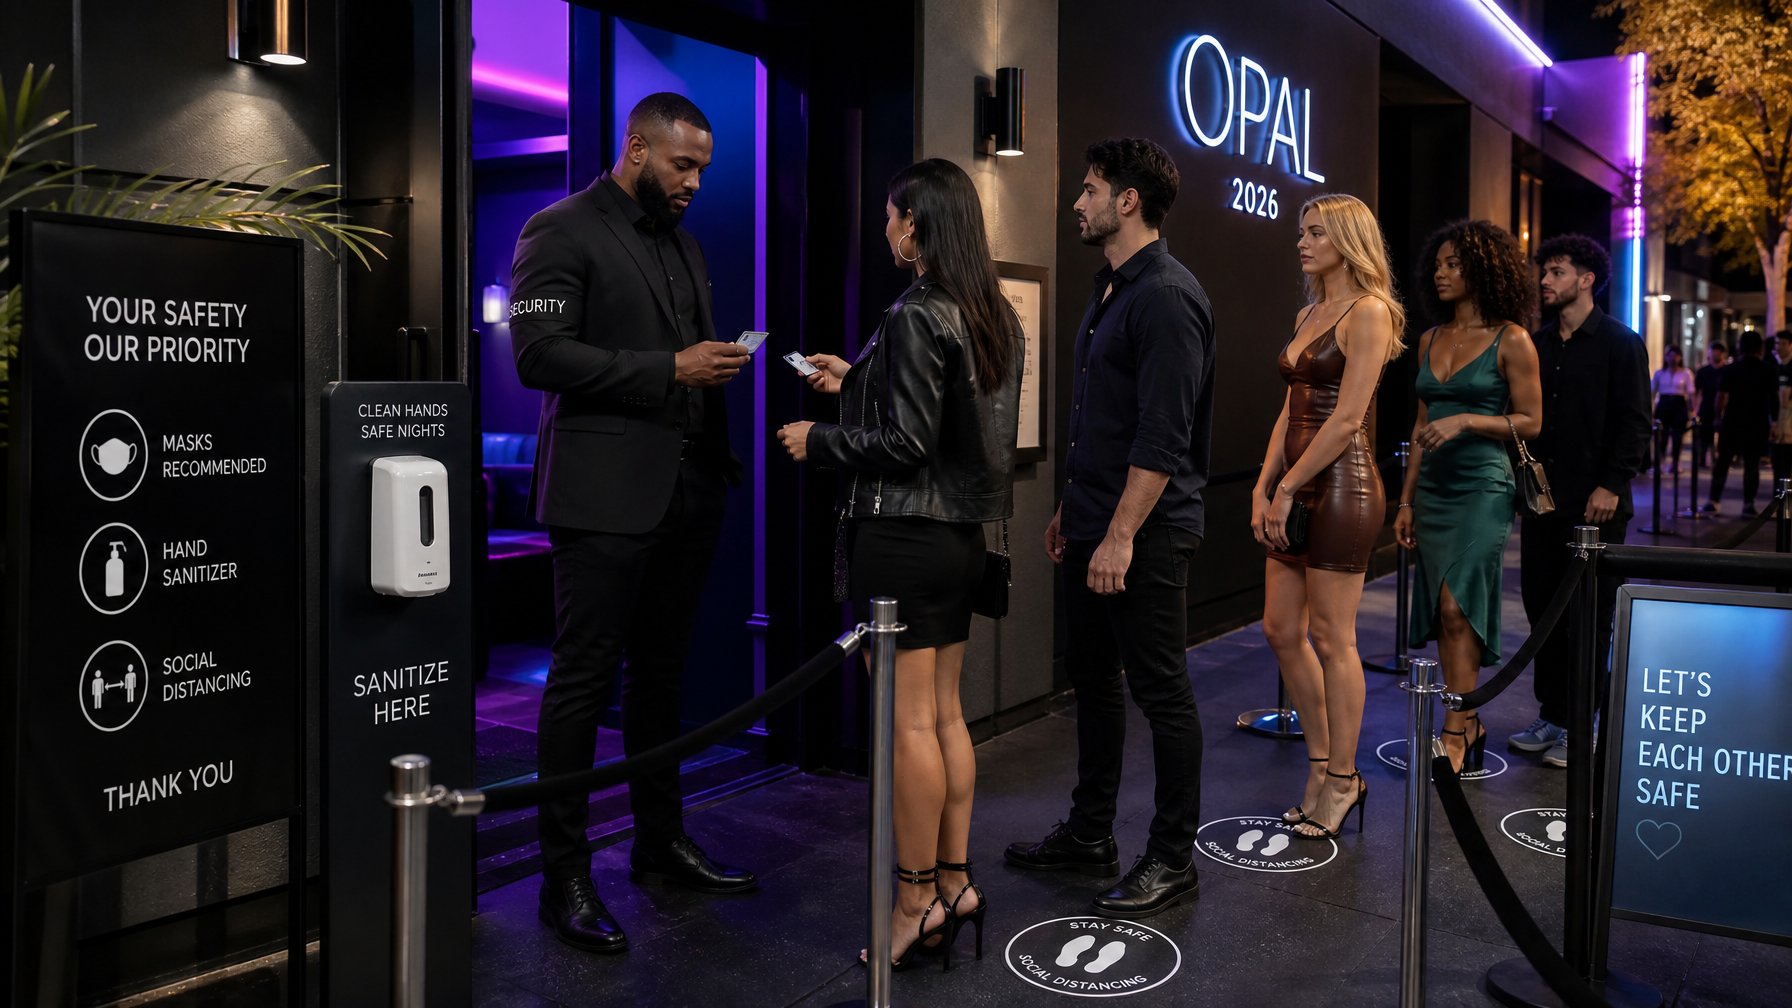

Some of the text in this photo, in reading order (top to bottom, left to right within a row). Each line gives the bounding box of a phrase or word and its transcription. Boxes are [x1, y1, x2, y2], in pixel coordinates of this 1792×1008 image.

[1184, 34, 1326, 184] OPAL
[1231, 176, 1279, 220] 2026
[86, 295, 247, 328] YOUR SAFETY
[509, 298, 566, 318] SECURITY
[84, 333, 250, 363] OUR PRIORITY
[358, 403, 448, 418] CLEAN HANDS
[163, 433, 213, 452] MASKS
[361, 423, 445, 439] SAFE NIGHTS
[163, 457, 267, 478] RECOMMENDED
[163, 539, 208, 560] HAND
[162, 562, 238, 587] SANITIZER
[162, 651, 217, 675] SOCIAL
[162, 670, 251, 702] DISTANCING
[353, 660, 449, 698] SANITIZE
[1642, 667, 1712, 698] LET’S
[373, 693, 431, 725] HERE
[1640, 703, 1707, 734] KEEP
[1637, 740, 1792, 781] EACH OTHER
[103, 759, 234, 812] THANK YOU
[1636, 777, 1701, 810] SAFE
[1239, 819, 1272, 827] STAY
[1204, 841, 1315, 868] SOCIAL DISTANCING
[1515, 831, 1552, 851] SOCIAL
[1069, 921, 1153, 942] STAY SAFE
[1019, 953, 1148, 991] SOCIAL DISTANCING
